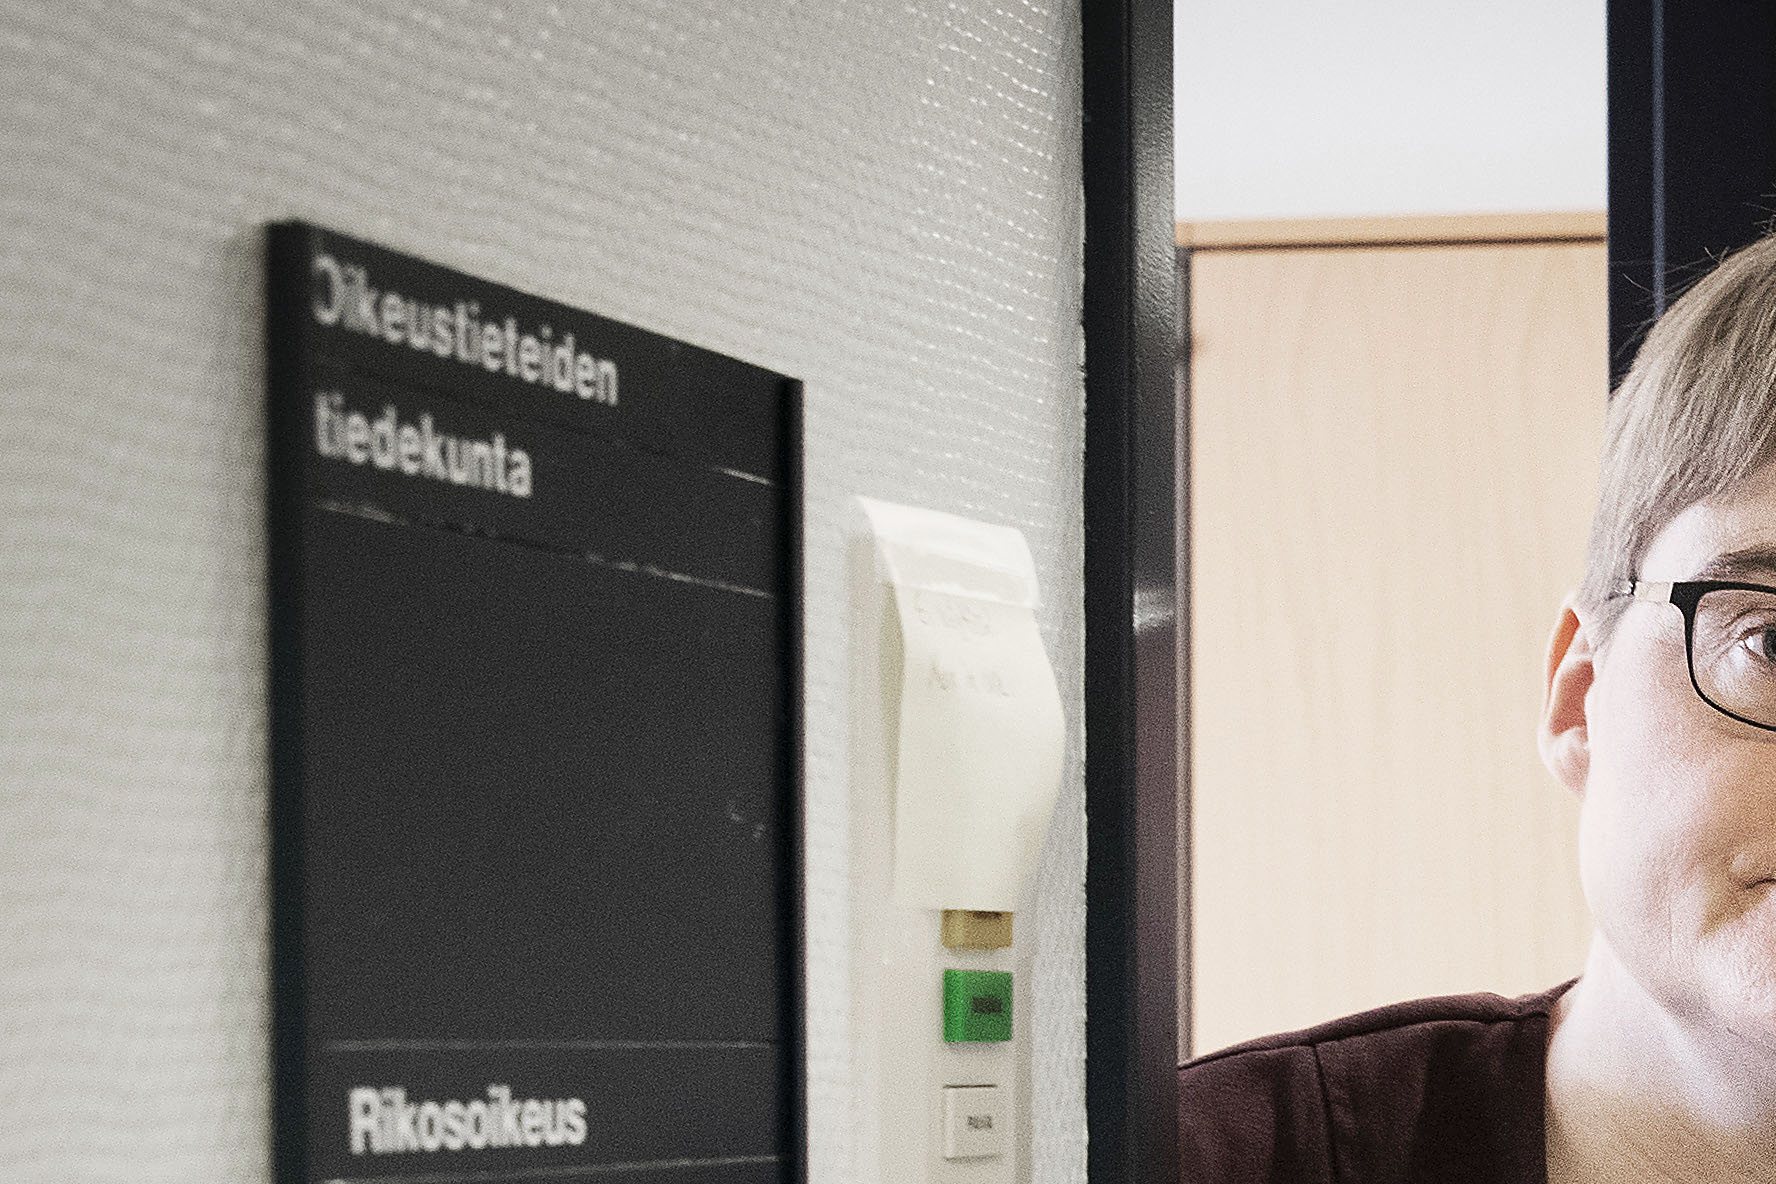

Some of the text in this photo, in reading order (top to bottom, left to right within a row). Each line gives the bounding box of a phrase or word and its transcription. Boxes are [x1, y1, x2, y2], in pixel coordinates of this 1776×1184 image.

[311, 254, 619, 406] Oikeustieteiden
[314, 391, 534, 498] tiedekunta
[348, 1083, 589, 1156] Rikosoikeus
